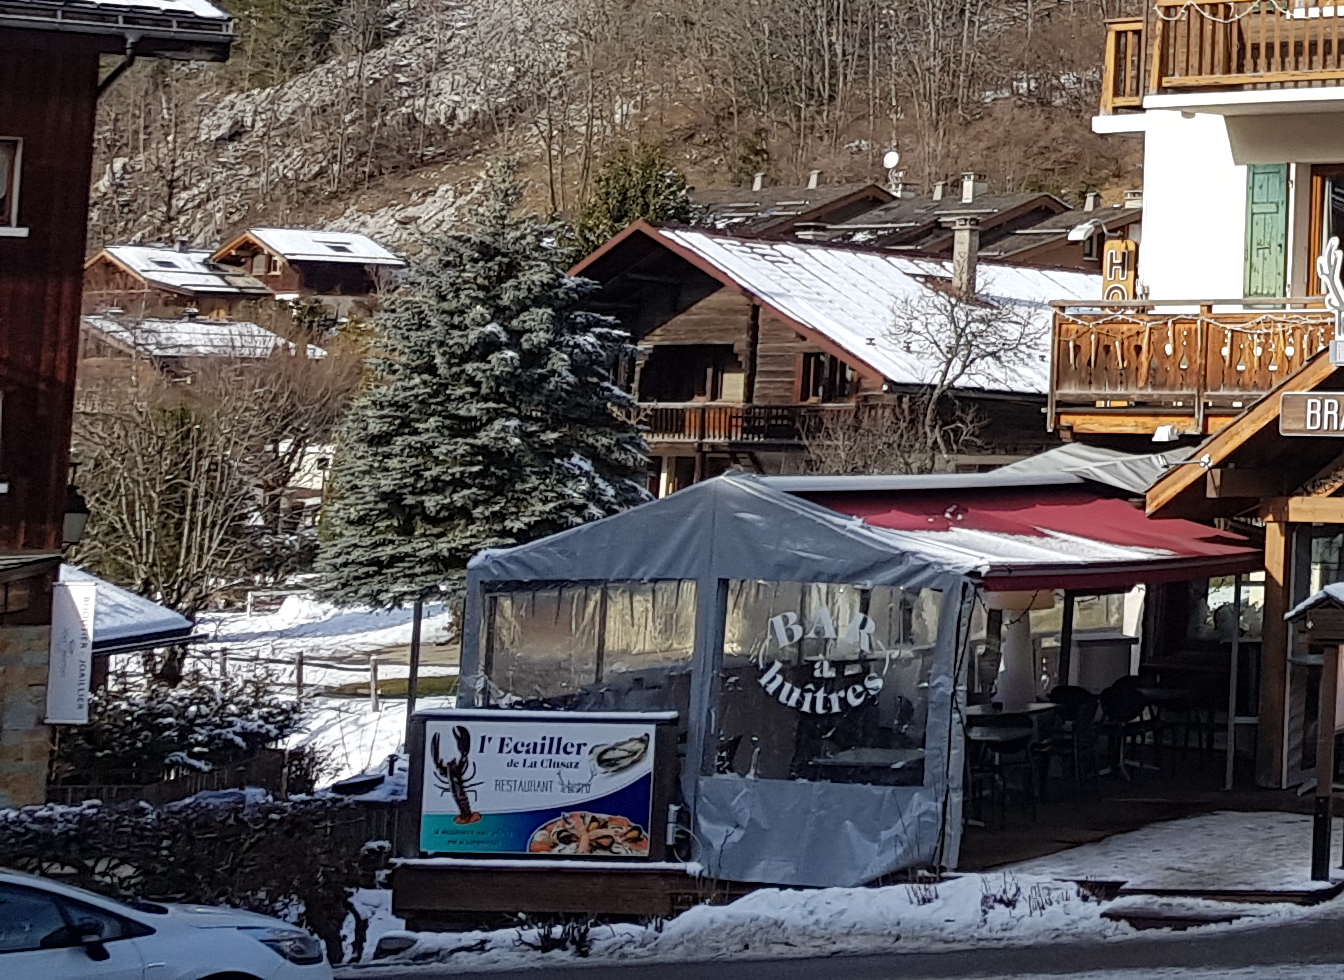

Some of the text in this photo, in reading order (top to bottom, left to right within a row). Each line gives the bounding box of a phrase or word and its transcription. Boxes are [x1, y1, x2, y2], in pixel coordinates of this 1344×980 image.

[770, 606, 876, 654] BAR
[757, 658, 884, 714] huîtres
[497, 736, 588, 756] Ecailler
[506, 758, 581, 770] de La Clusaz
[494, 779, 554, 794] RESTAURANT
